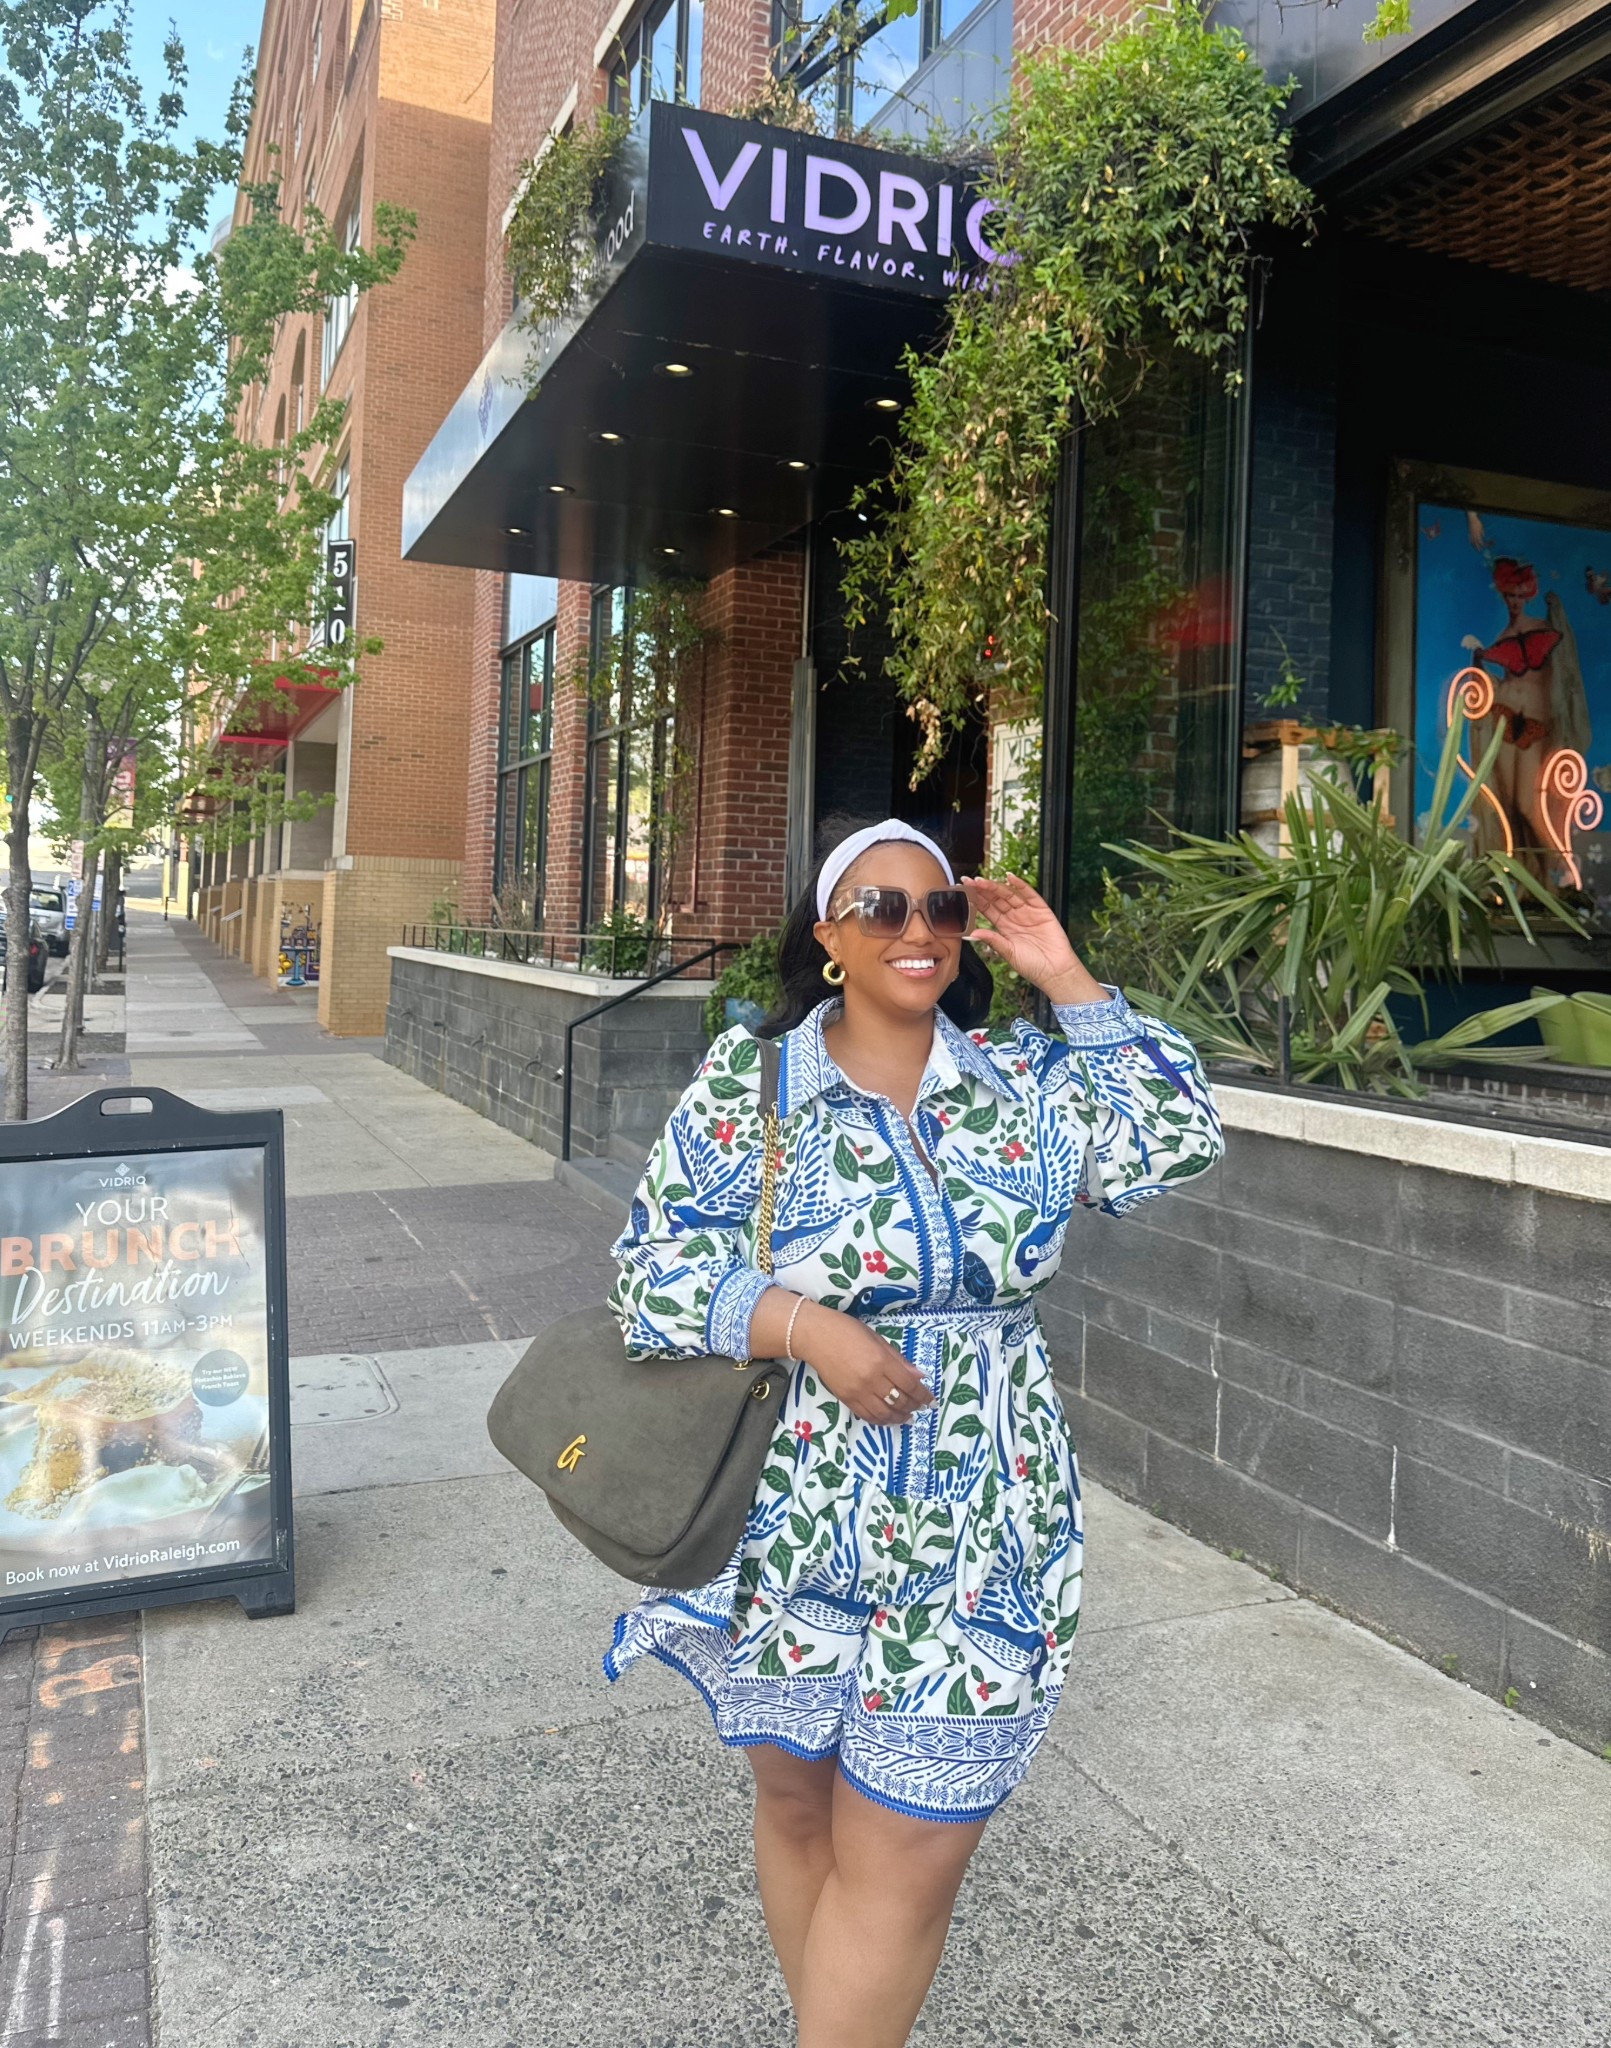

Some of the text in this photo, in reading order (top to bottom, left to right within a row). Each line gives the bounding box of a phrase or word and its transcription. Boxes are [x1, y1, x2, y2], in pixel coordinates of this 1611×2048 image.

[703, 222, 999, 295] EARTH. FLAVOR. WIN
[76, 1197, 169, 1227] YOUR
[0, 1218, 241, 1276] BRUNCH
[11, 1259, 230, 1325] Destination
[9, 1314, 233, 1349] WEEKENDS 11AM-3PM
[6, 1540, 240, 1585] Book now at VidrioRaleigh.com
